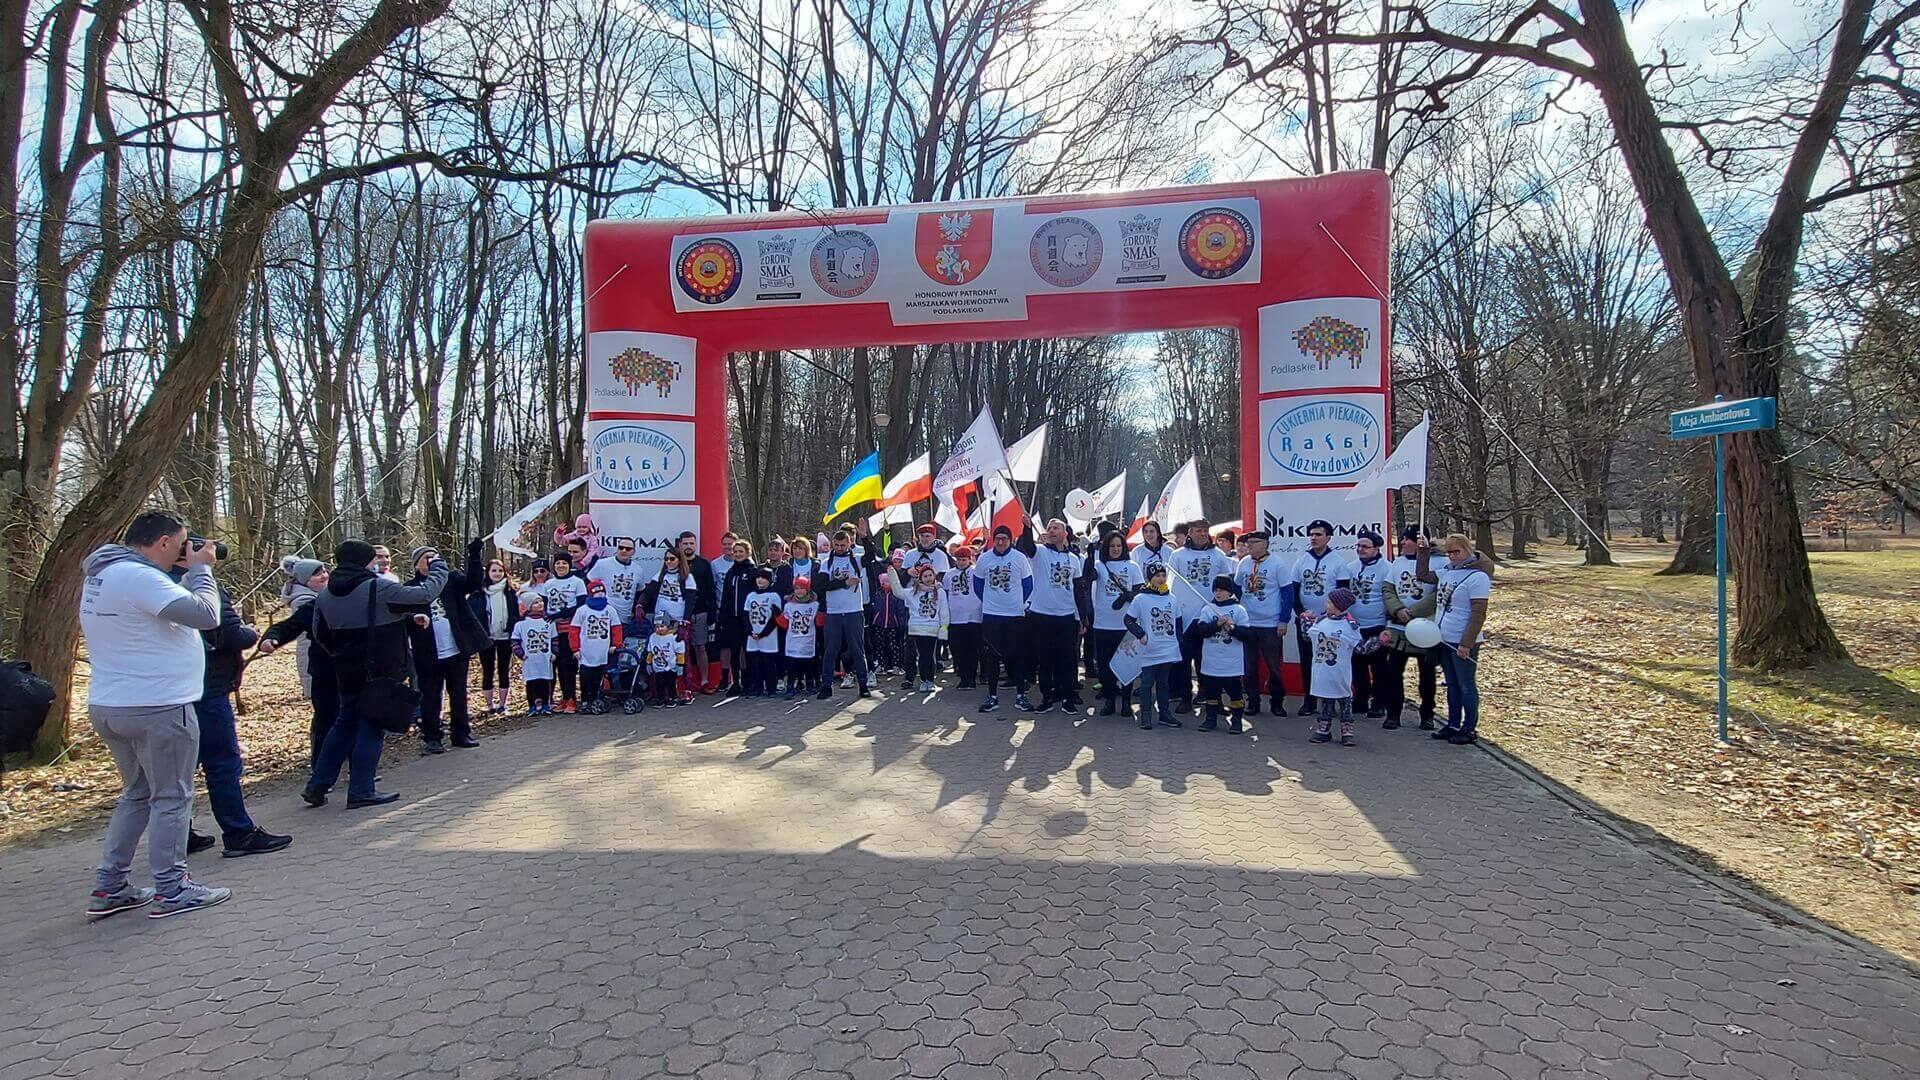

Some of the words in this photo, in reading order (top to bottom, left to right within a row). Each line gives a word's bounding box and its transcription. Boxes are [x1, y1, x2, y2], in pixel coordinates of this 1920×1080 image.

[1123, 235, 1157, 246] ZDROWY
[1123, 245, 1157, 260] SMAK
[760, 254, 791, 265] ZDROWY
[760, 265, 791, 278] SMAK
[915, 291, 958, 299] HONOROWY
[960, 289, 997, 297] PATRONAT
[951, 297, 1009, 306] WOJEWÓDZTWA
[933, 307, 984, 315] PODLASKIEGO
[1271, 363, 1316, 375] Podlaskie
[594, 387, 627, 397] Podlaskie
[1276, 407, 1325, 435] CUKIERNIA
[1328, 405, 1373, 432] PIEKARNIA
[1679, 414, 1698, 428] Aleja
[1699, 408, 1750, 424] Ambientowa
[594, 431, 625, 454] CUKIERNIA
[629, 431, 674, 455] PIEKARNIA
[1289, 449, 1366, 473] Rozwadowski
[601, 471, 665, 490] Rozwadowski
